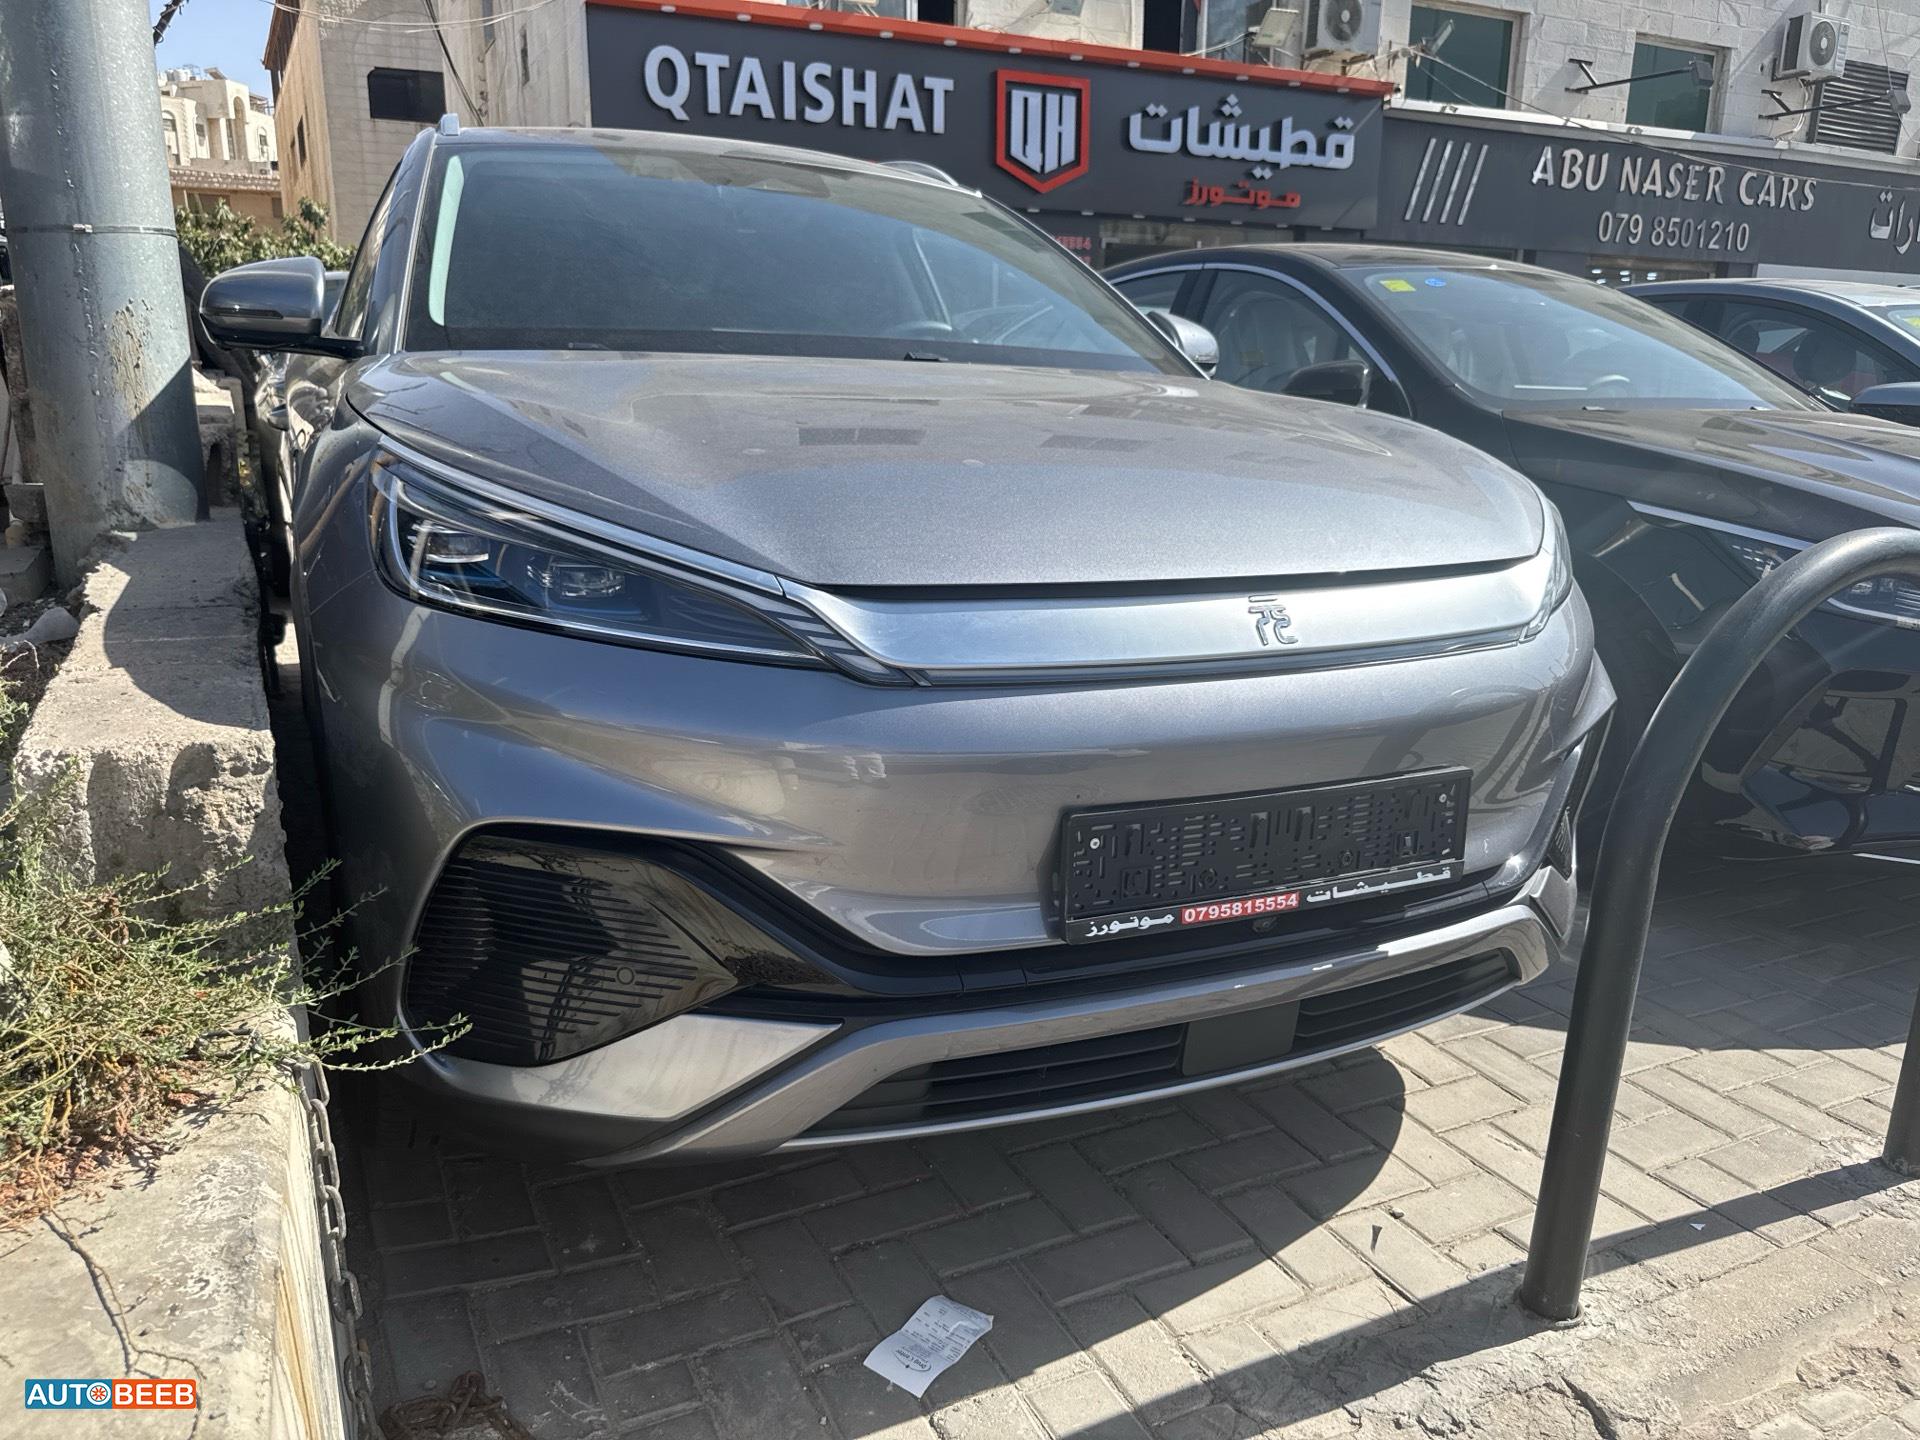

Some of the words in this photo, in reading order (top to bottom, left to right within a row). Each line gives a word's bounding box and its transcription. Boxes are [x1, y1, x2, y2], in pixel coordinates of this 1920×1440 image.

[644, 44, 955, 134] QTAISHAT
[1129, 93, 1355, 180] قطيشات
[1184, 176, 1301, 209] موتورز
[1531, 145, 1610, 191] ABU
[1619, 155, 1727, 205] NASER
[1738, 170, 1817, 211] CARS
[1599, 211, 1644, 245] 079
[1650, 216, 1750, 252] 8501210
[1305, 866, 1451, 903] قطيشات
[1085, 912, 1175, 937] موتورز
[1183, 893, 1298, 923] 0795815554
